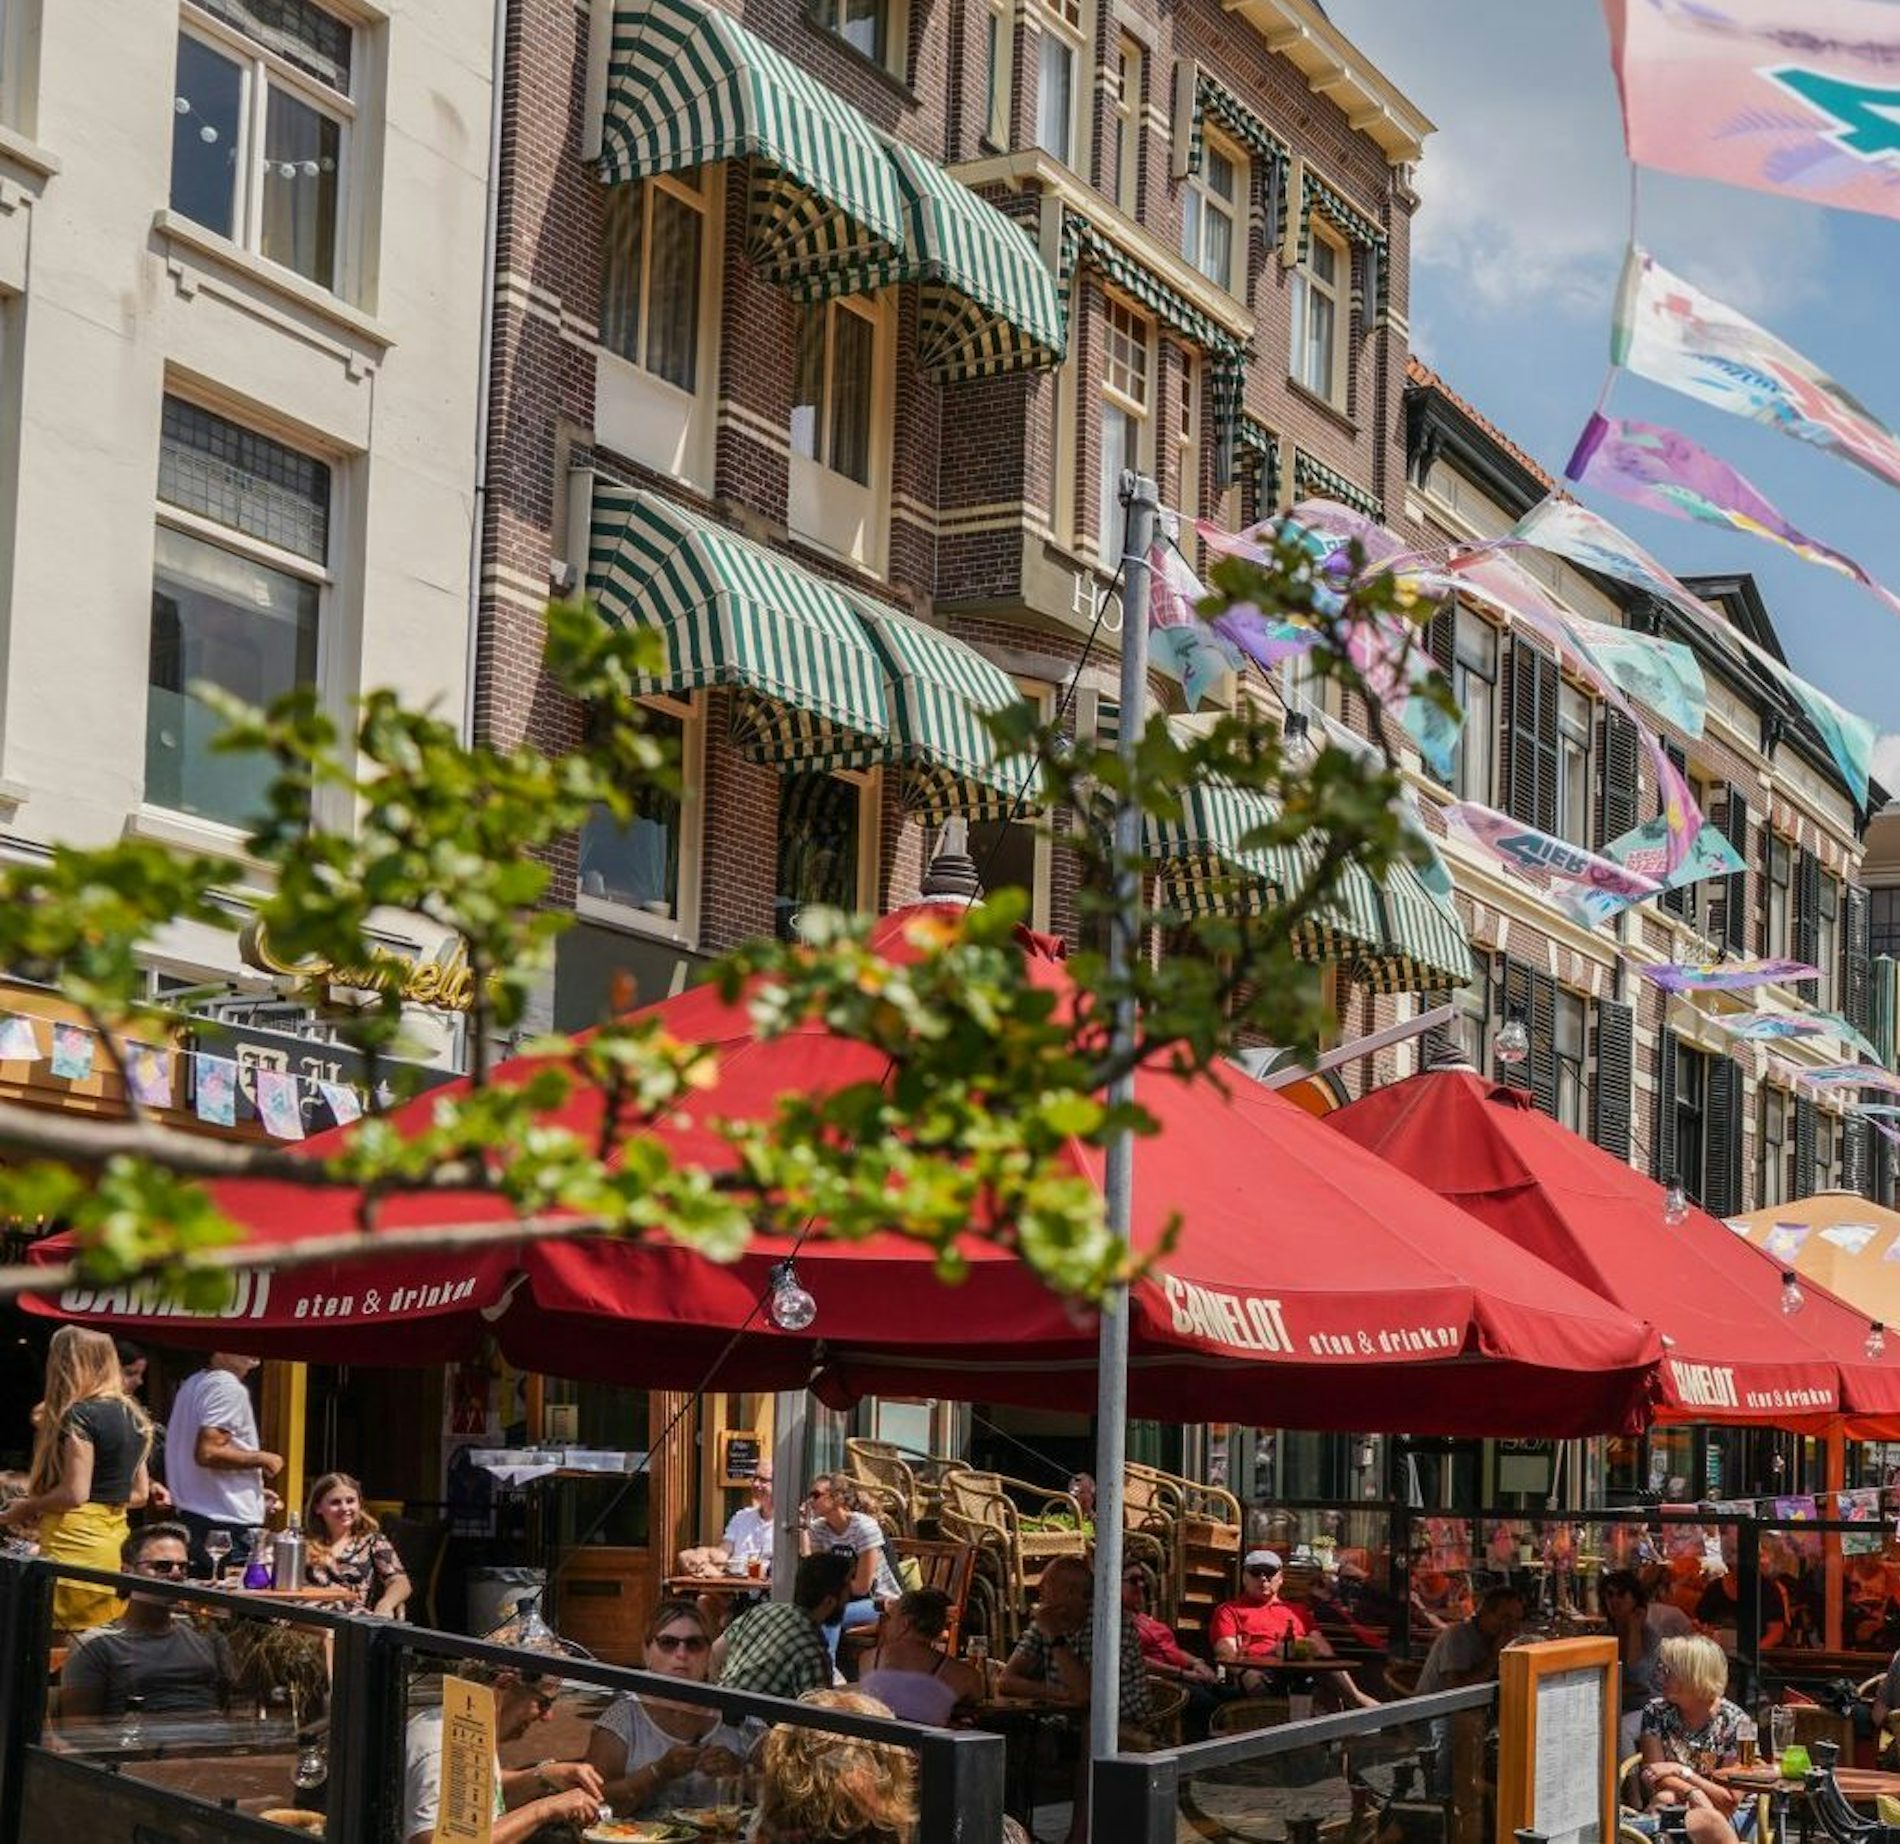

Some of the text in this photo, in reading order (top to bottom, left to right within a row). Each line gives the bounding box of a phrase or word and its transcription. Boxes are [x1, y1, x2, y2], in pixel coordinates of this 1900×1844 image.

[294, 1295, 354, 1320] eten
[361, 1288, 381, 1316] &
[388, 1276, 478, 1314] drinken
[1164, 1273, 1459, 1356] CAMELOT eten & drinken
[1670, 1359, 1739, 1408] CAMELOT
[1784, 1387, 1833, 1408] drinken
